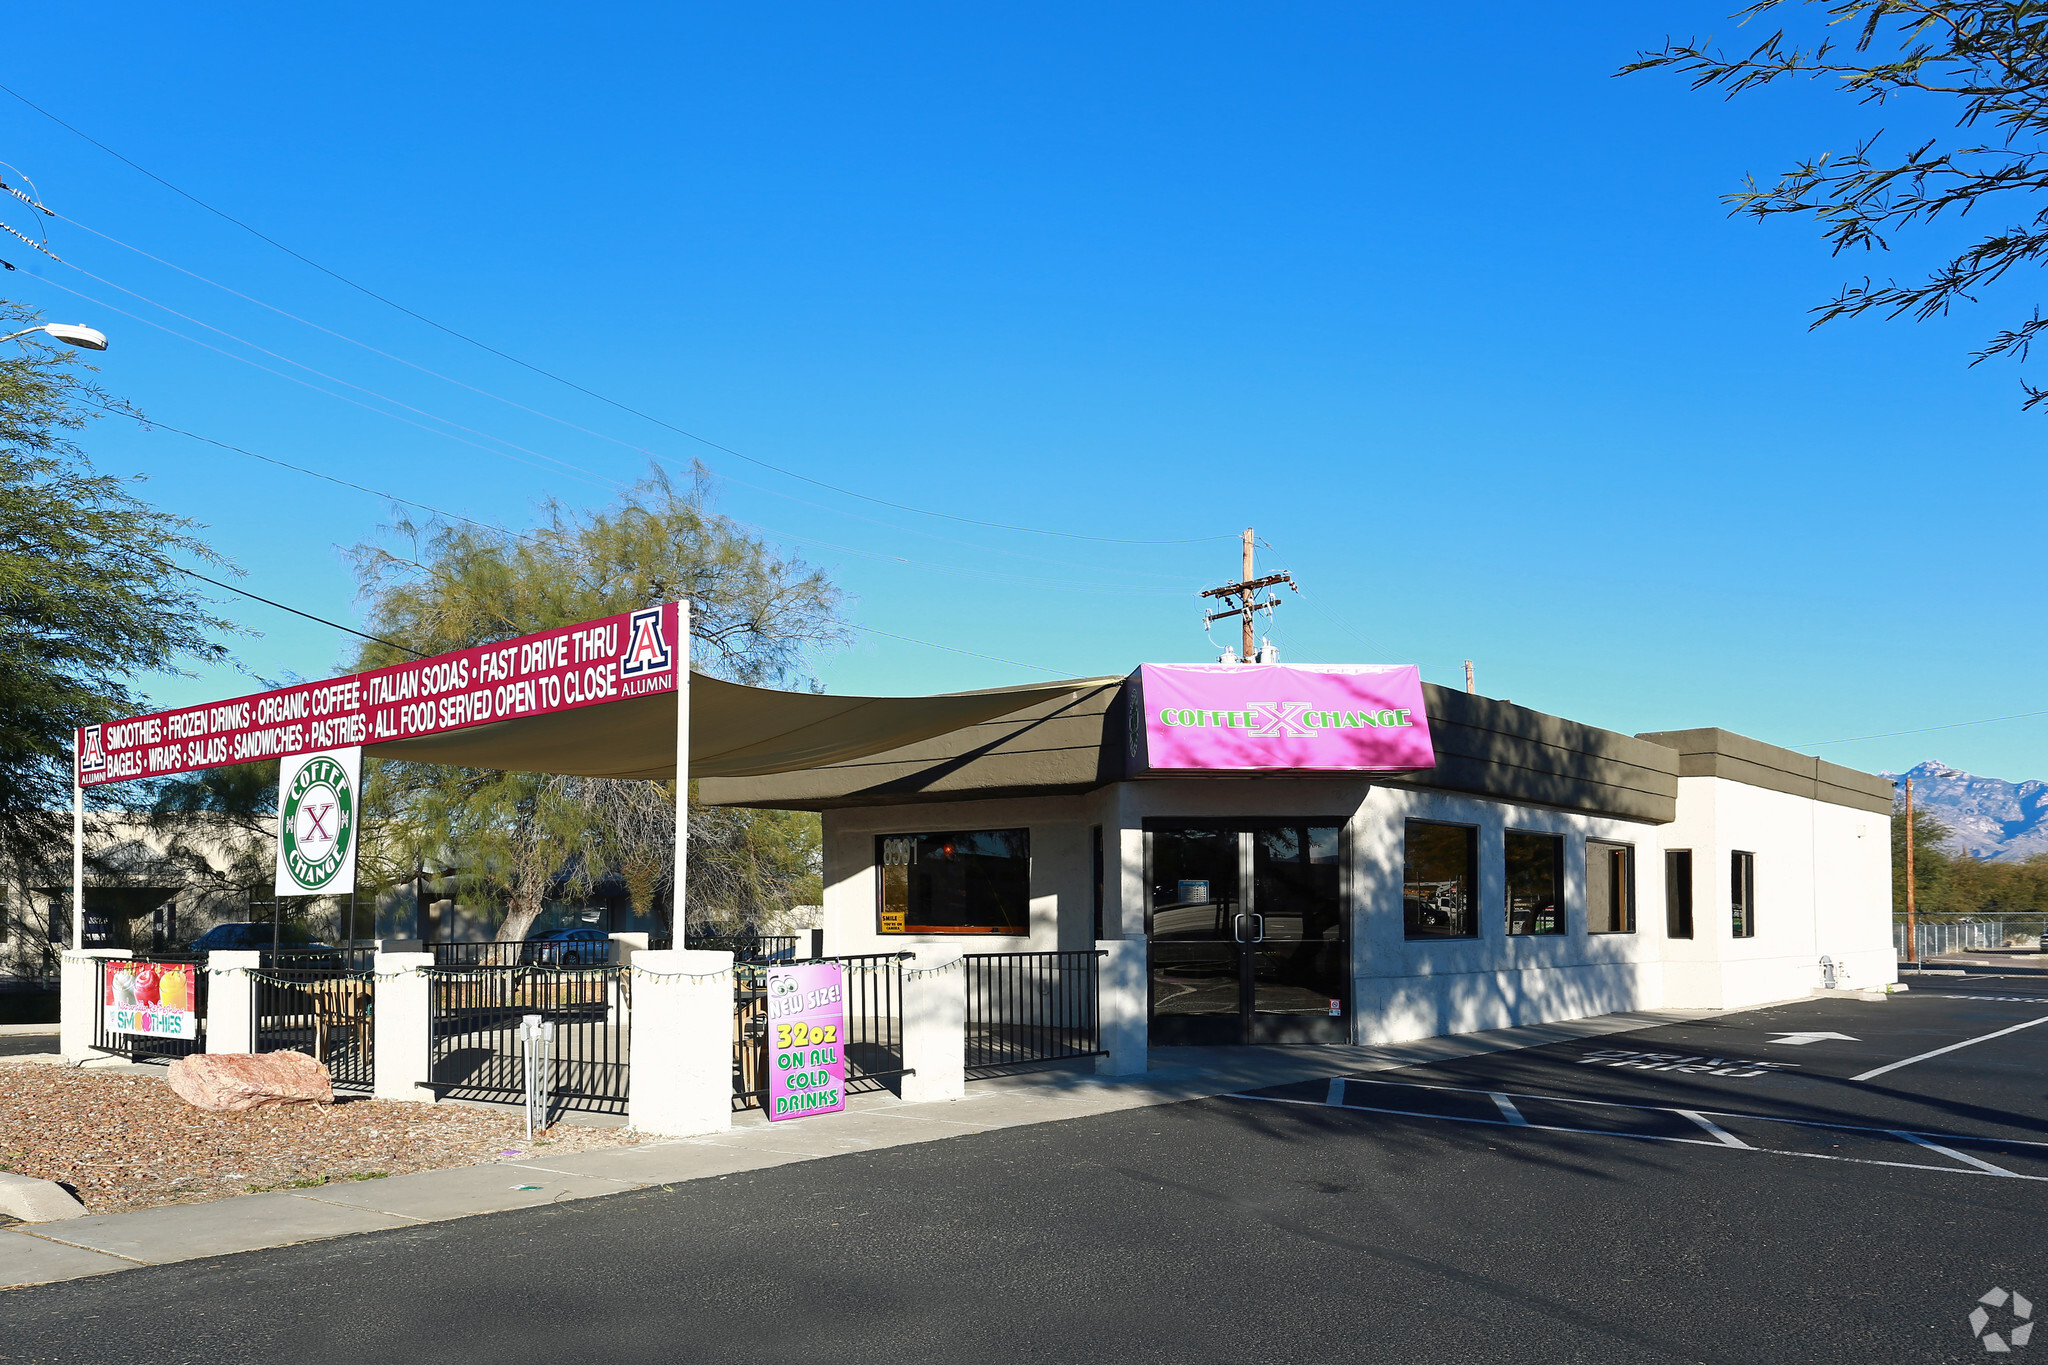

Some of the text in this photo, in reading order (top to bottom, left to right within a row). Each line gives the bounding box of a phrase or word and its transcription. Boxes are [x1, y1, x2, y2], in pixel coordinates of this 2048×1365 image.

[107, 623, 618, 751] SMOOTHIES FROZEN DRINKS ORGANIC COFFEE ITALIAN SODAS FAST DRIVE THRU
[621, 674, 672, 697] ALUMNI
[107, 662, 617, 778] BAGELS WRAPS SALADS SANDWICHES PASTRIES ALL FOOD SERVED OPEN TO CLOSE
[1160, 707, 1260, 728] COFFEE
[1302, 708, 1413, 729] CHANGE
[81, 771, 107, 785] ALUMNI
[290, 762, 348, 800] COFFEE
[300, 803, 335, 843] X
[289, 844, 344, 883] CHANGE
[769, 984, 841, 1019] NEW SIZE!
[117, 1011, 182, 1034] SMOOTHIES
[777, 1047, 837, 1070] ON ALL
[1576, 1056, 1769, 1078] THRU
[1582, 1050, 1801, 1071] DRIVE
[786, 1070, 830, 1090] COLD
[776, 1089, 839, 1115] DRINKS
